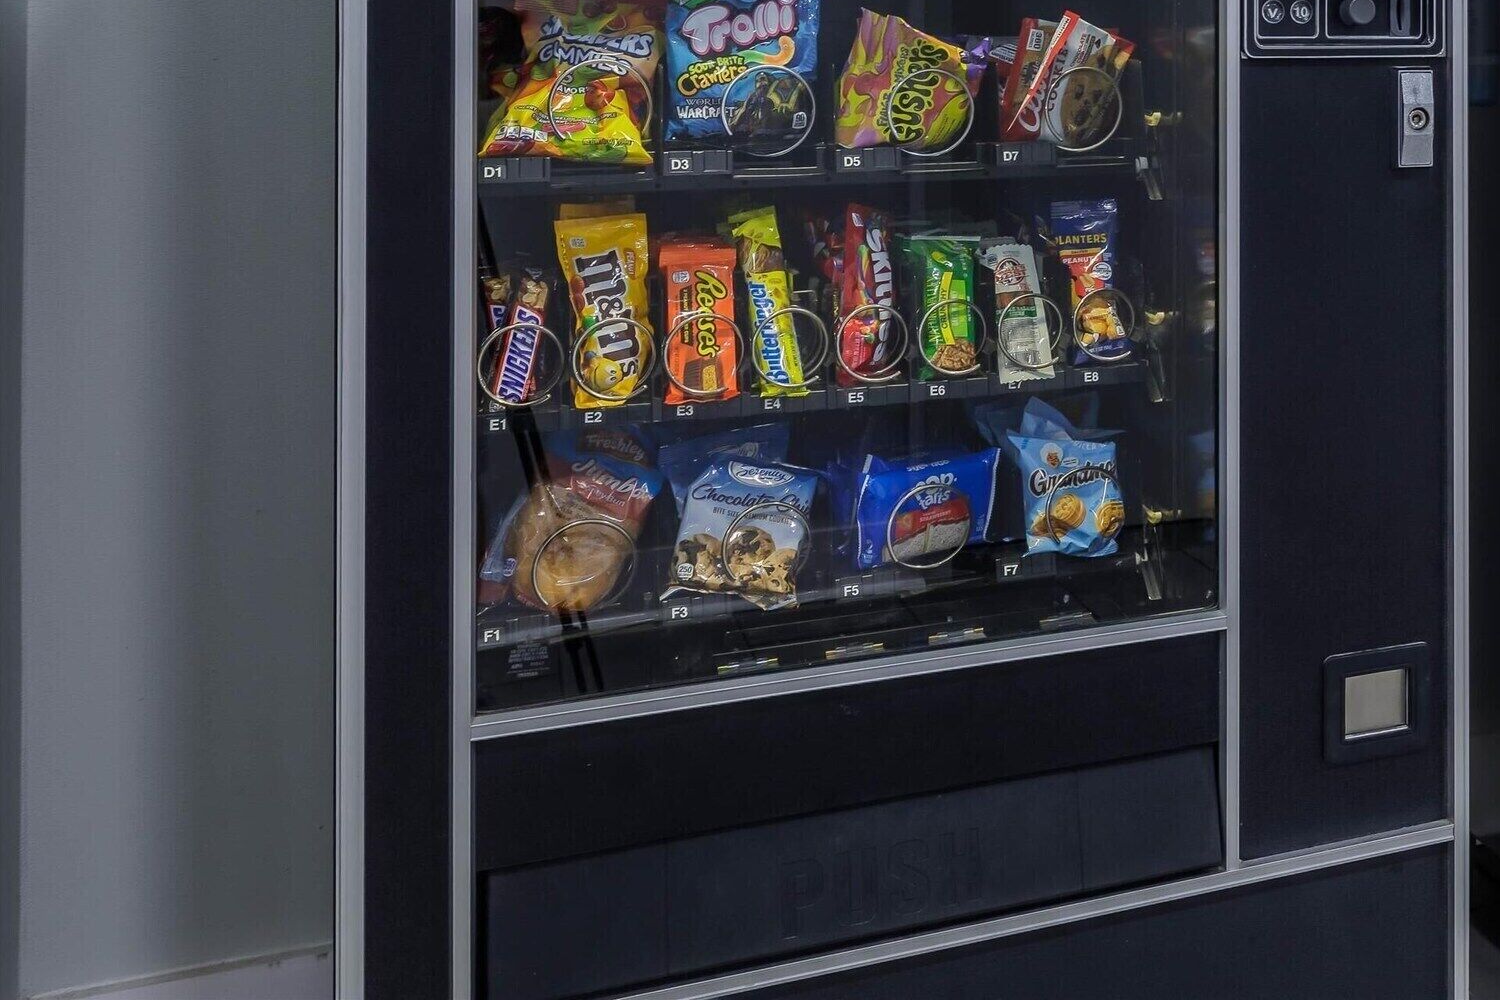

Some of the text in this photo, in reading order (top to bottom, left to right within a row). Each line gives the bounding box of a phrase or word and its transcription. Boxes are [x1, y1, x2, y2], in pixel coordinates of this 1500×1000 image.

[1295, 7, 1308, 18] 10
[716, 56, 745, 66] BRITE
[677, 65, 748, 97] Crawlers
[844, 156, 861, 167] D5
[1003, 151, 1019, 161] D7
[671, 159, 690, 170] D3
[484, 167, 502, 178] D1
[1054, 233, 1108, 246] PLANTERS
[694, 271, 728, 358] Reese's
[748, 281, 790, 384] Butterfinger
[499, 304, 543, 403] SNICKERS
[1084, 372, 1099, 382] E8
[930, 386, 946, 396] E6
[848, 392, 864, 403] E5
[764, 399, 781, 410] E4
[676, 406, 694, 416] E3
[584, 412, 602, 423] E2
[489, 418, 507, 431] E1
[692, 483, 775, 509] Chocolate
[713, 506, 725, 515] BITE
[679, 566, 693, 574] 250
[1004, 564, 1018, 576] F7
[843, 585, 859, 596] F5
[671, 607, 688, 618] F3
[483, 630, 500, 643] F1
